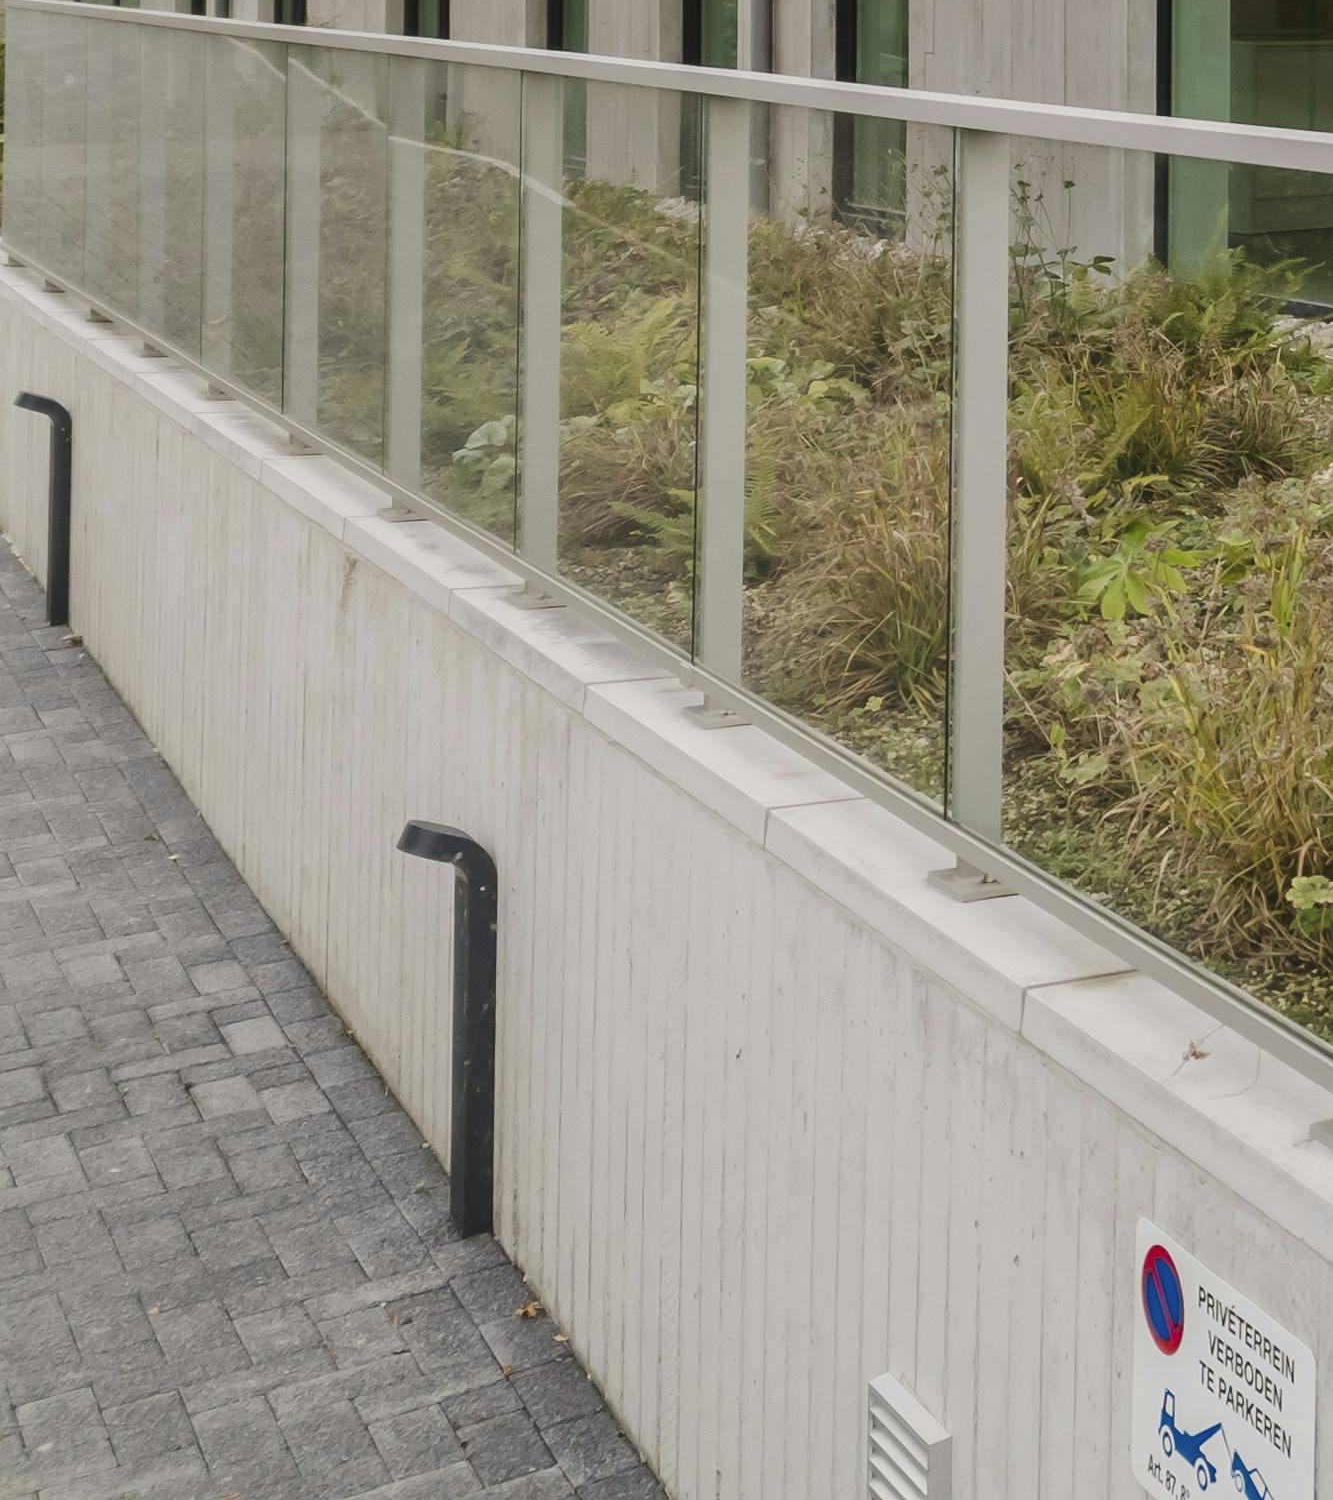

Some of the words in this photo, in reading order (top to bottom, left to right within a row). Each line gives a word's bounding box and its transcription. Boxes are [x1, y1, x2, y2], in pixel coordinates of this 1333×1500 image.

[1198, 1285, 1295, 1383] PRIVÉTERREIN
[1208, 1330, 1283, 1412] VERBODEN
[1199, 1360, 1215, 1393] TE
[1218, 1377, 1292, 1459] PARKEREN
[1147, 1453, 1163, 1485] Art.
